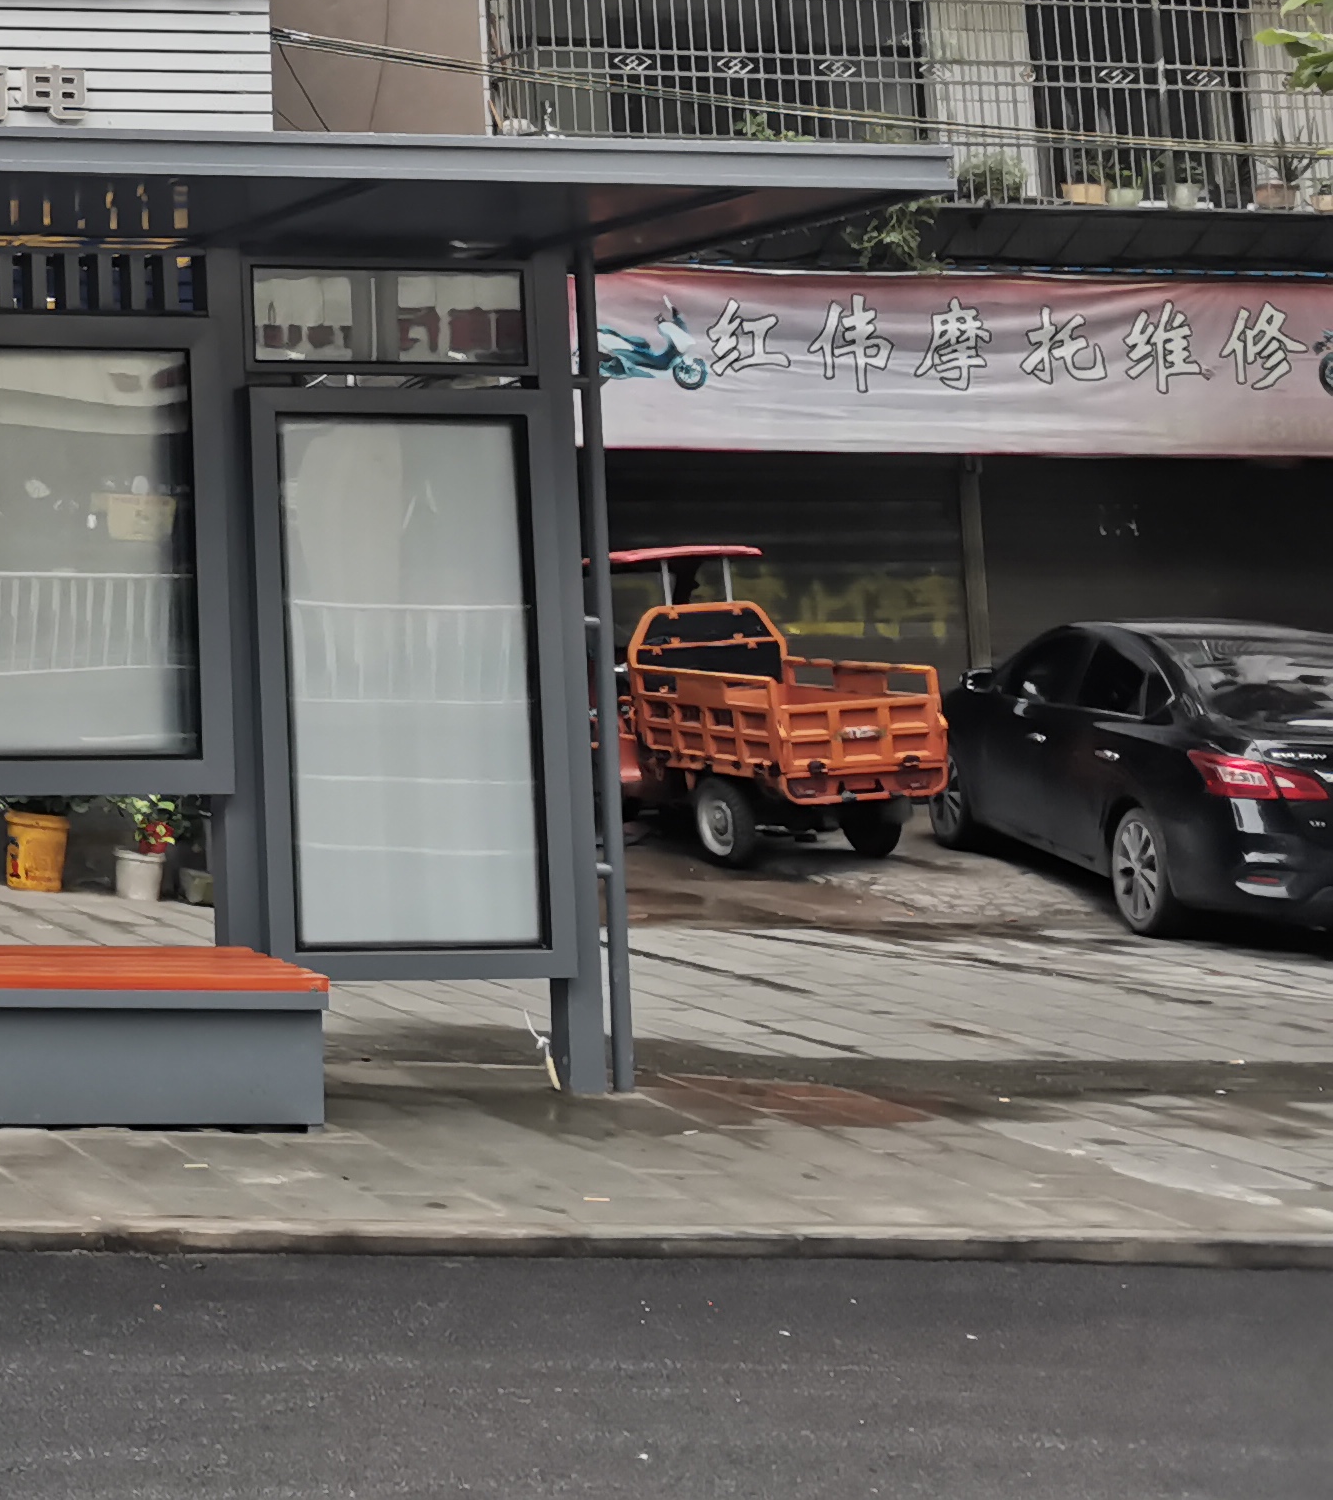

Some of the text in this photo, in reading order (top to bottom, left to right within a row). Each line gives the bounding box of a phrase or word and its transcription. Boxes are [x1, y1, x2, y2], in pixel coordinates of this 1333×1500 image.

[706, 294, 1309, 394] 红伟摩托维修
